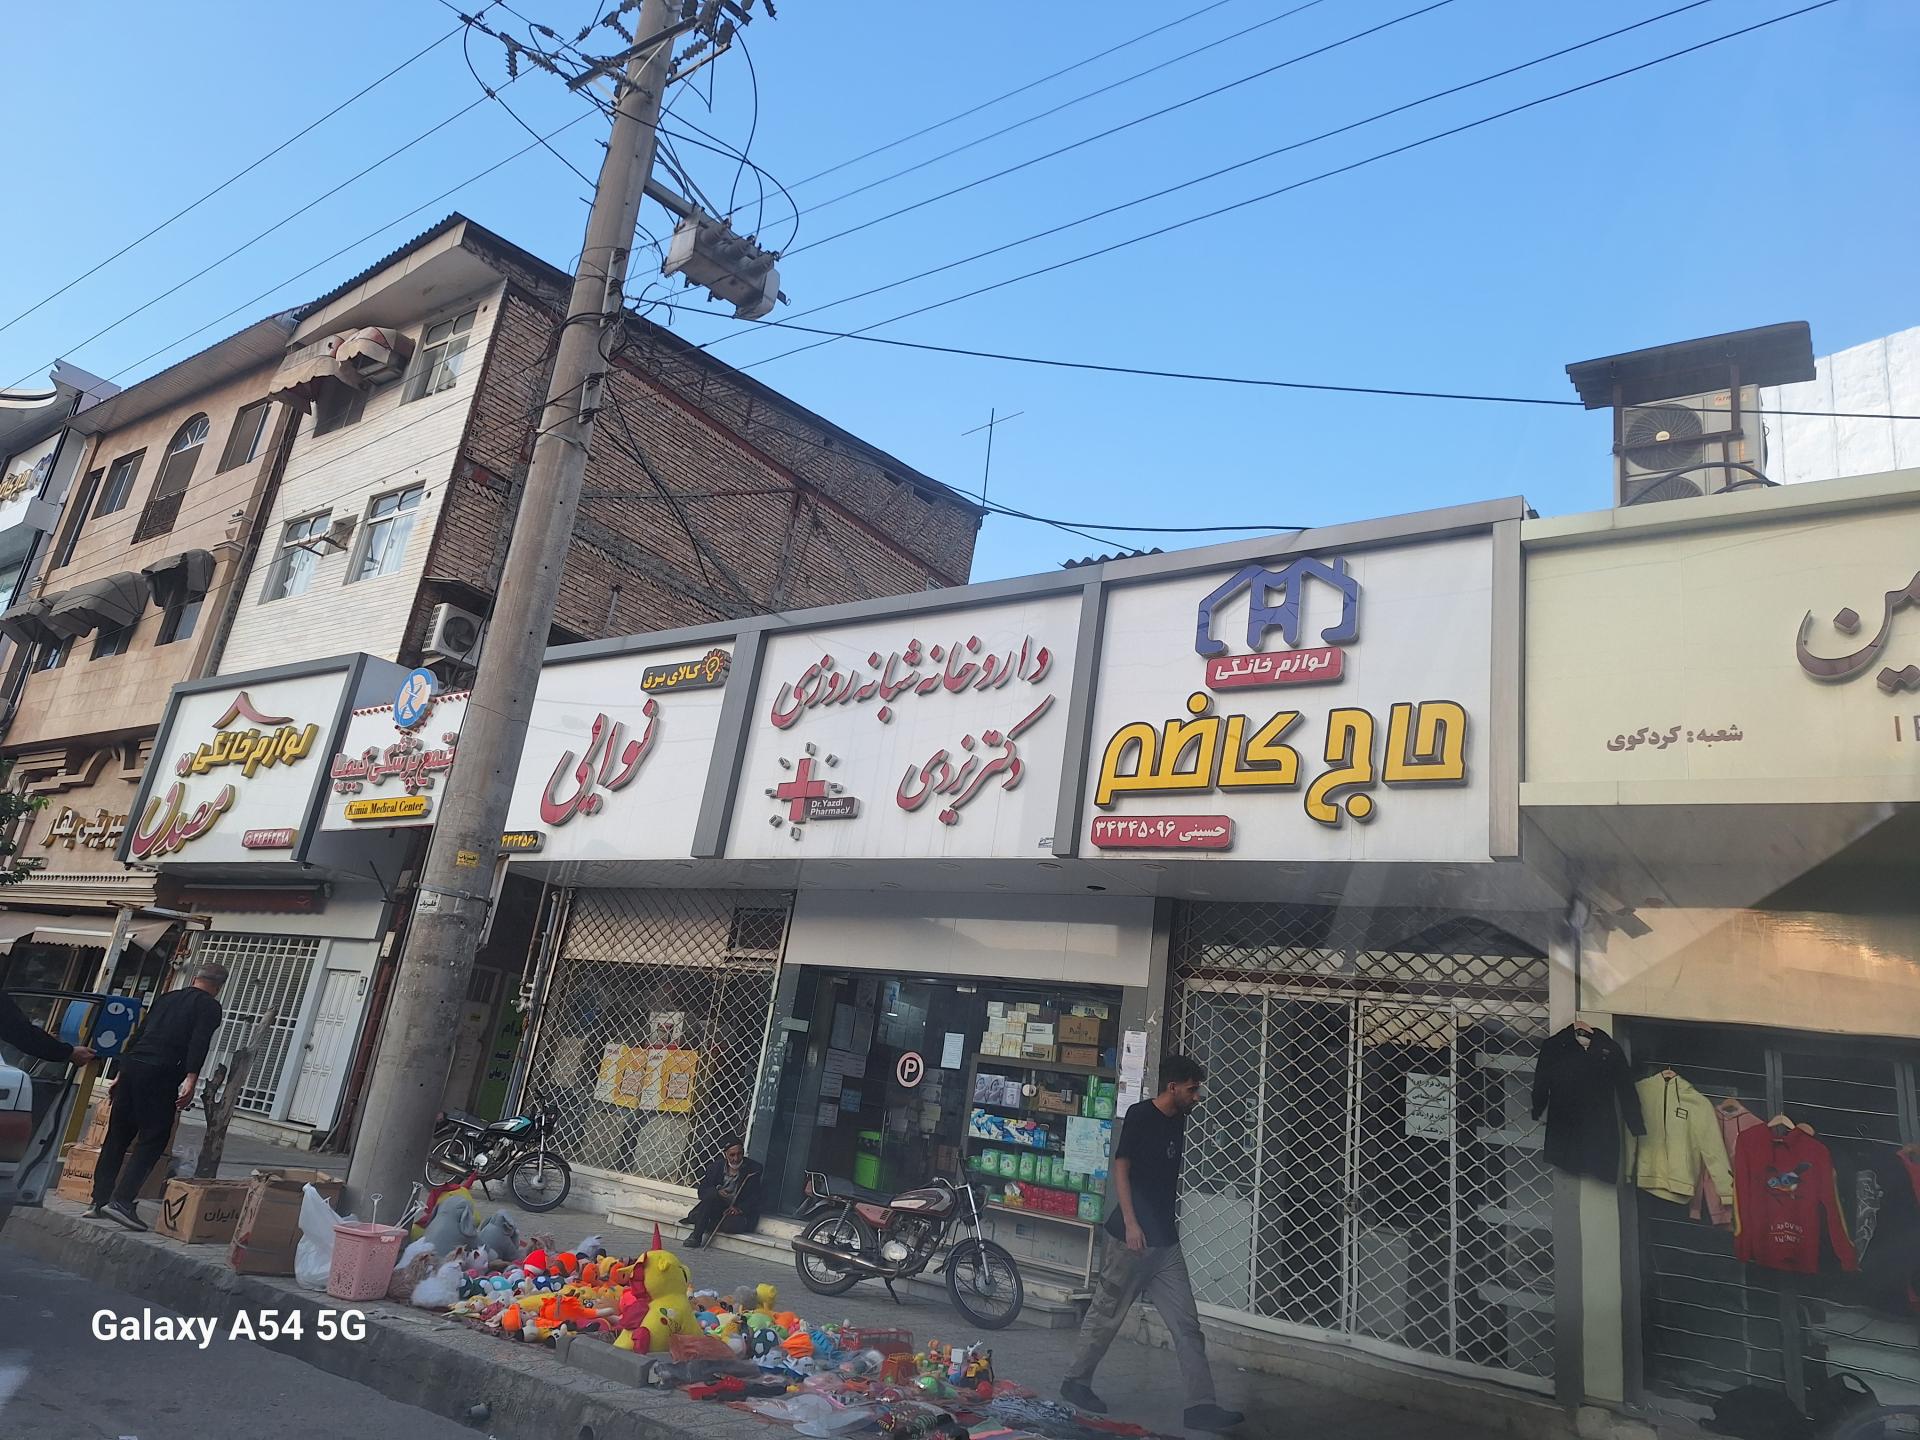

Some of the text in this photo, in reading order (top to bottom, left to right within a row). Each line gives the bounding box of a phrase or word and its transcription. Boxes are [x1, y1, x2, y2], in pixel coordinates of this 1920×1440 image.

[642, 663, 702, 690] کالای برق
[1214, 651, 1332, 683] لوازم خانگی
[191, 723, 320, 779] لوازم خانگی
[1606, 725, 1682, 752] کردکوی
[330, 746, 379, 794] کیمیا
[415, 731, 459, 787] جتمع
[1304, 699, 1469, 826] حاج
[347, 800, 424, 816] Kimia Medical Center
[810, 805, 851, 817] Pharmacy
[1095, 820, 1227, 842] ۳۴۳۴۵۰۹۶ حسینی
[904, 1059, 918, 1080] P
